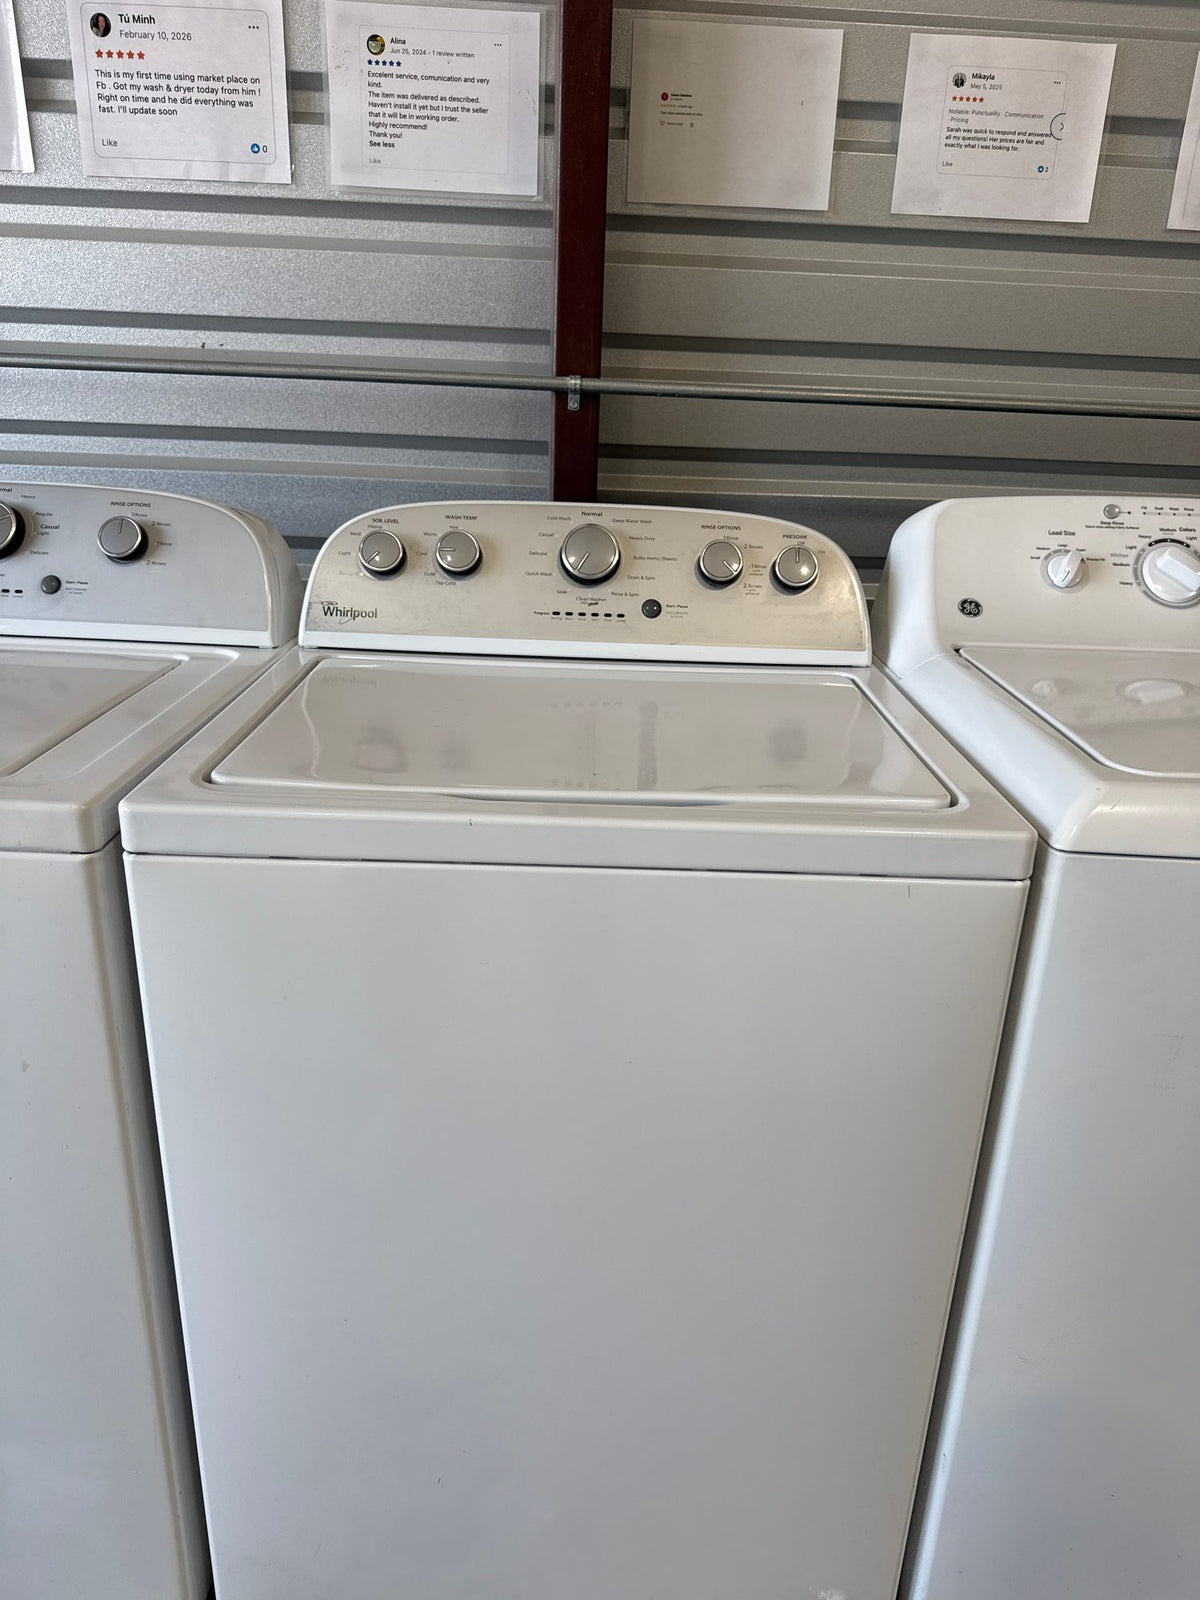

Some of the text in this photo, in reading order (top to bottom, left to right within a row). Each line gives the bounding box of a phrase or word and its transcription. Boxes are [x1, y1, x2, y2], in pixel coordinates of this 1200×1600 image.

[118, 14, 156, 24] Tú Minh
[119, 30, 192, 42] February 10, 2026
[402, 48, 410, 56] 25,
[95, 69, 260, 85] This is my first time using market place on
[396, 72, 420, 82] service,
[420, 74, 462, 82] comunication
[463, 76, 475, 84] and
[476, 78, 490, 86] very
[972, 73, 995, 81] Mikayla
[96, 81, 256, 96] Fb Got my wash & dryer today from him
[368, 80, 382, 88] kind.
[98, 93, 118, 104] Right
[132, 94, 150, 104] time
[152, 94, 166, 104] and
[168, 96, 178, 104] he
[180, 96, 192, 105] did
[194, 97, 236, 108] everything
[238, 100, 254, 108] was
[448, 96, 480, 104] described.
[98, 104, 178, 116] fast. I'll update soon
[394, 102, 412, 110] install
[418, 104, 428, 112] yet
[472, 106, 488, 114] seller
[408, 112, 414, 120] in
[416, 113, 440, 122] working
[441, 114, 460, 122] order.
[368, 121, 428, 130] Highly recommend!
[102, 138, 268, 153] Like 0
[369, 140, 381, 148] See
[945, 142, 962, 150] exactly
[992, 144, 1010, 152] looking
[322, 604, 378, 622] Whirlpool
